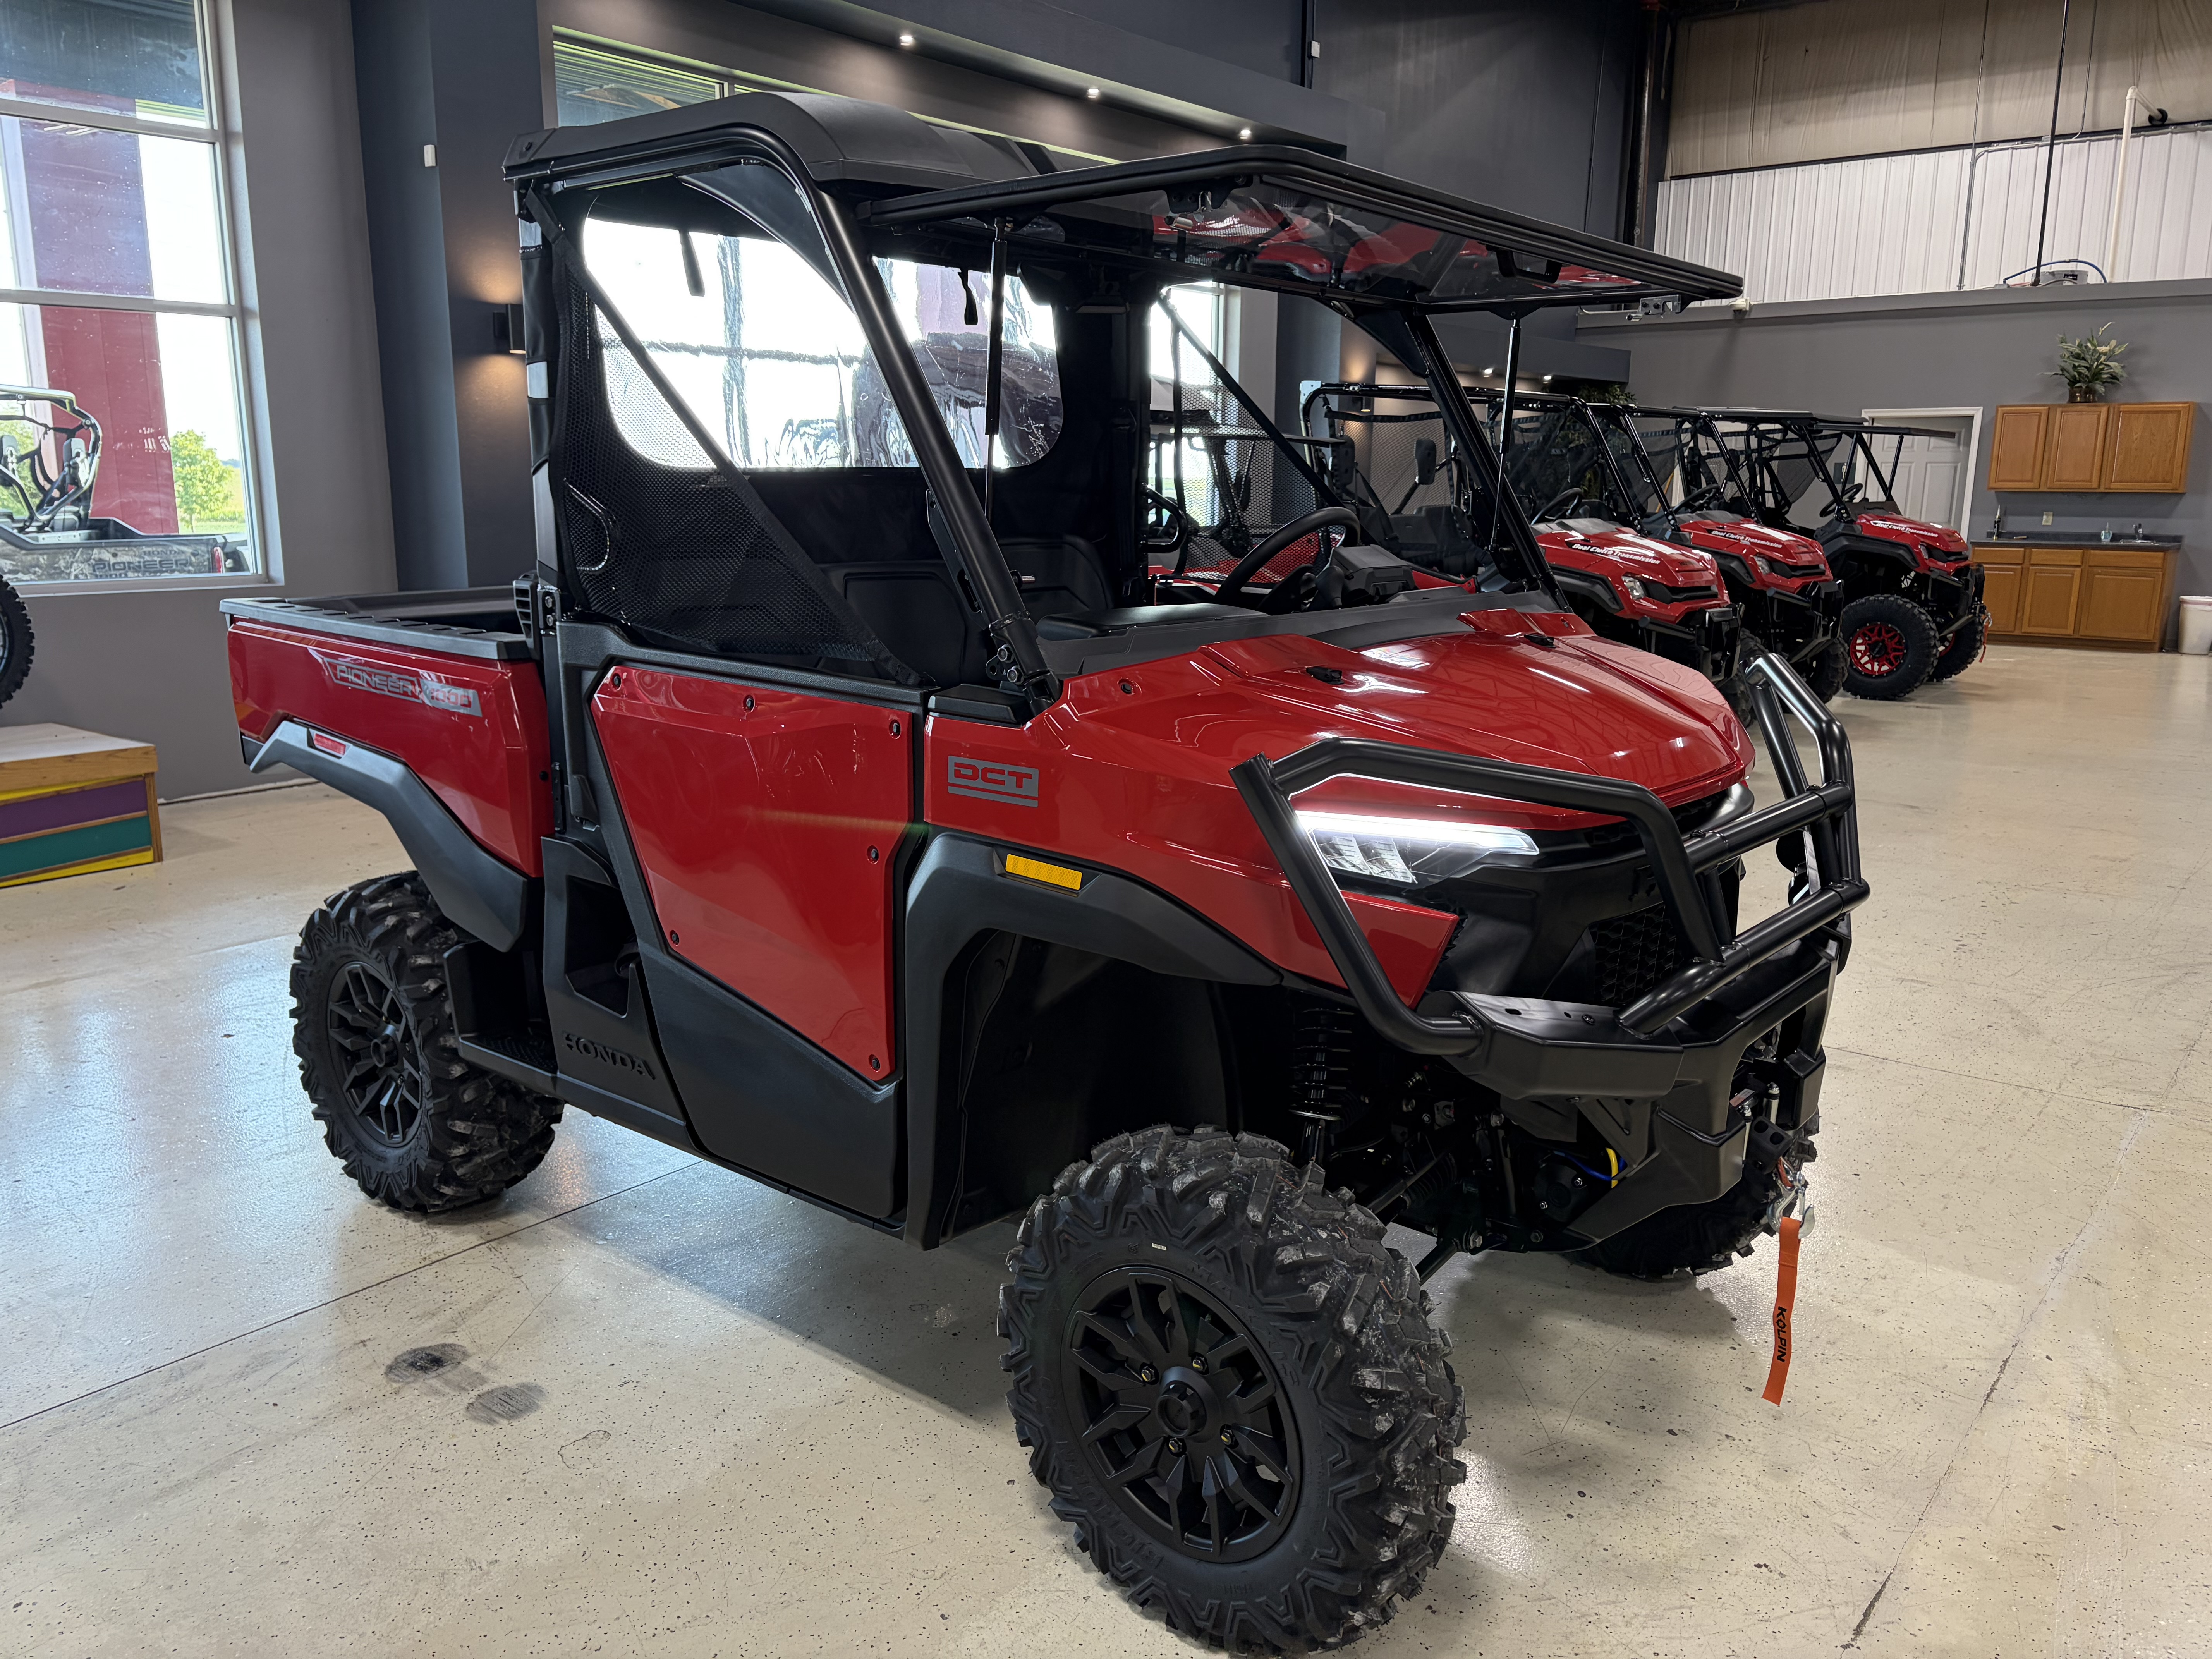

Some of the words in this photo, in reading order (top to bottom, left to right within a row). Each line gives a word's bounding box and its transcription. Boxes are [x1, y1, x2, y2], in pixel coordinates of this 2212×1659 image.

[1590, 546, 1613, 555] Clutch
[1614, 550, 1661, 565] Transmission
[1745, 536, 1783, 548] Transmission
[93, 558, 189, 572] PIONEER
[337, 665, 412, 696] PIONEER
[430, 687, 472, 708] 1000
[954, 761, 1033, 789] DCT
[562, 1032, 656, 1080] HONDA
[1775, 1306, 1788, 1363] KOLPIN
